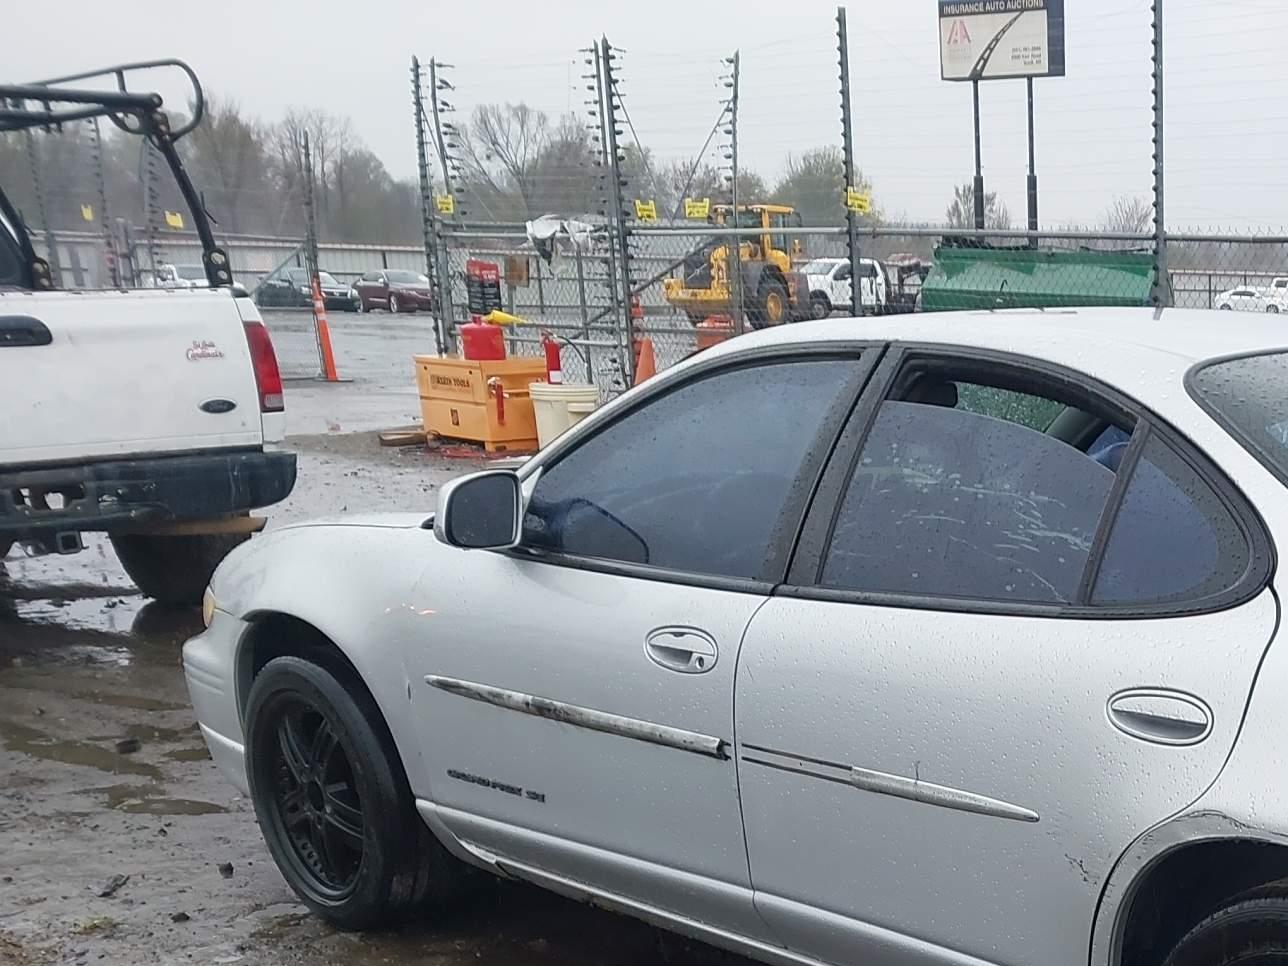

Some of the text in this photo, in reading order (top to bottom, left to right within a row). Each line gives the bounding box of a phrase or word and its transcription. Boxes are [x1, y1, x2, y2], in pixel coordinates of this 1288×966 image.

[943, 0, 1043, 14] INSURANCE AUTO AUCTIONS
